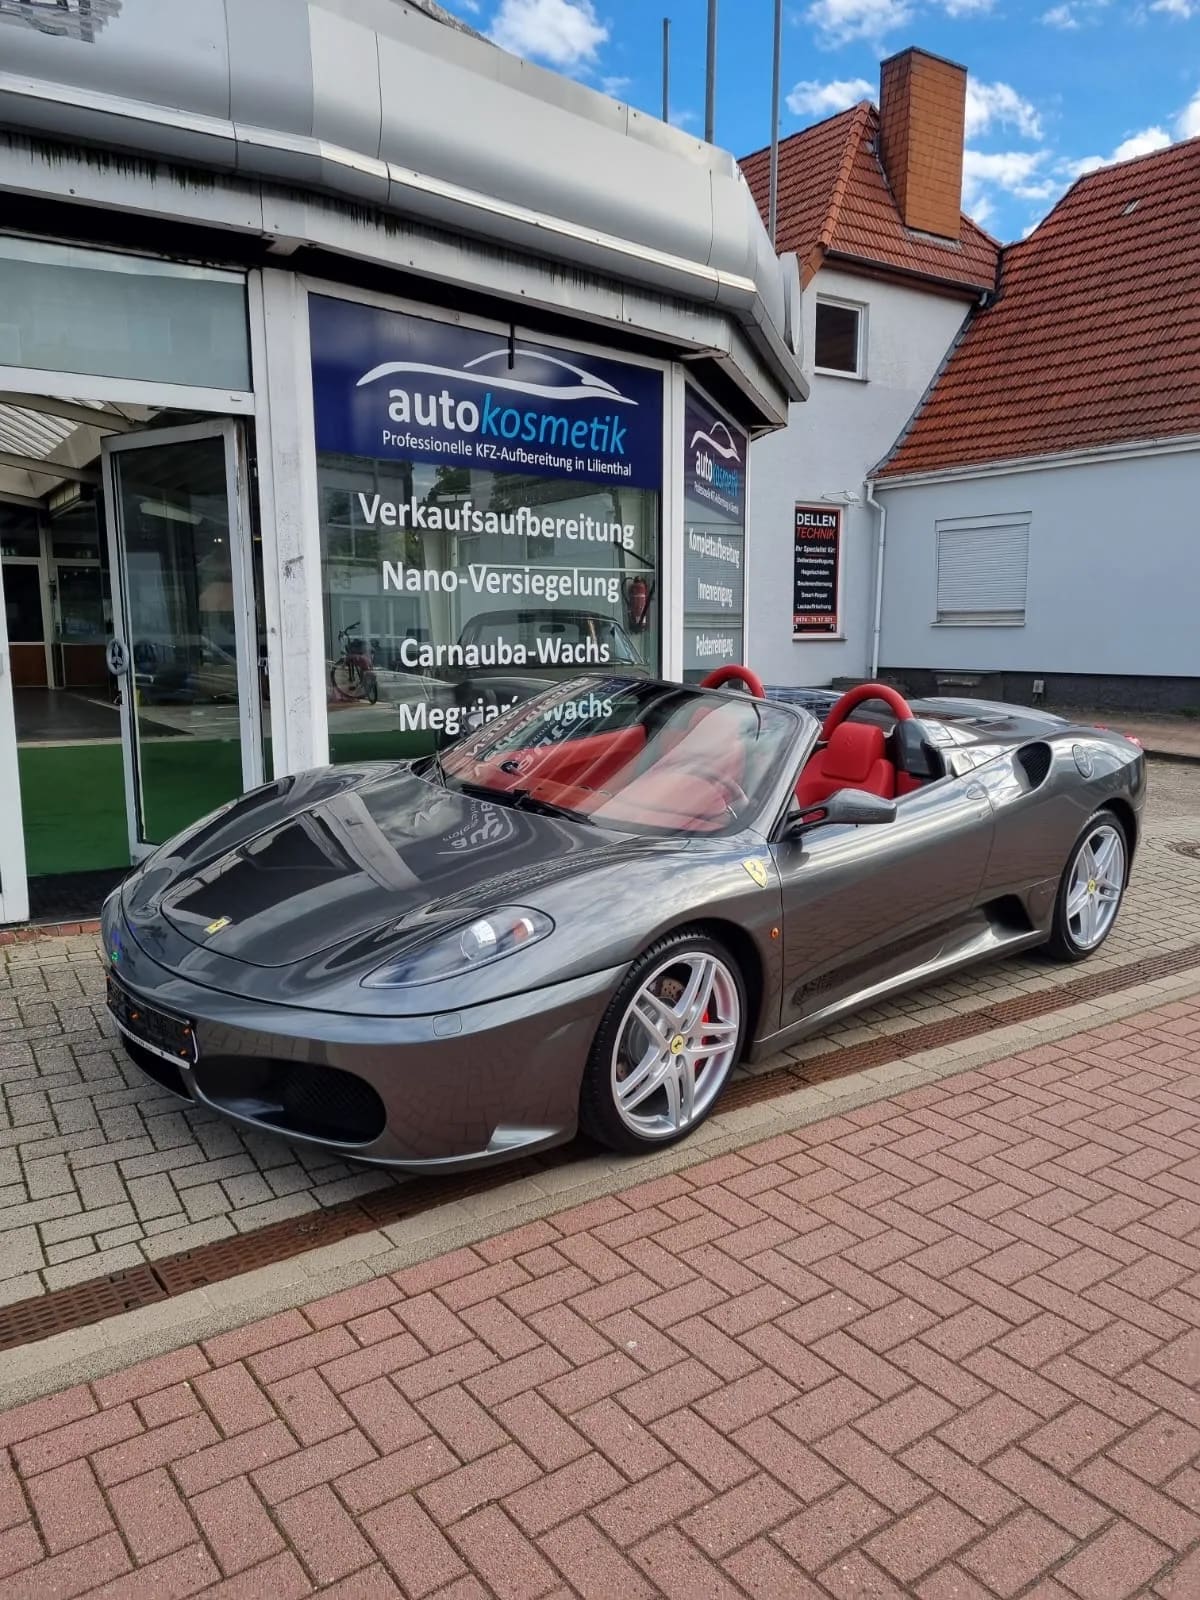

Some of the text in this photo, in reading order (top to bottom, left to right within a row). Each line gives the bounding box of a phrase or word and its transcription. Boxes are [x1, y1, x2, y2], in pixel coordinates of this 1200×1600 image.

[388, 388, 628, 455] autokosmetik
[382, 429, 632, 477] Professionelle KFZ-Aufbereitung in Lilienthal
[358, 492, 636, 549] Verkaufsaufbereitung
[796, 512, 836, 527] DELLEN
[796, 526, 836, 539] TECHNIK
[688, 527, 740, 569] Komplettaufbereitung
[382, 560, 620, 603] Nano-Versiegelung
[697, 577, 733, 608] Innenreinigung
[400, 635, 611, 667] Carnauba-Wachs
[696, 633, 734, 659] Polsterreinigung
